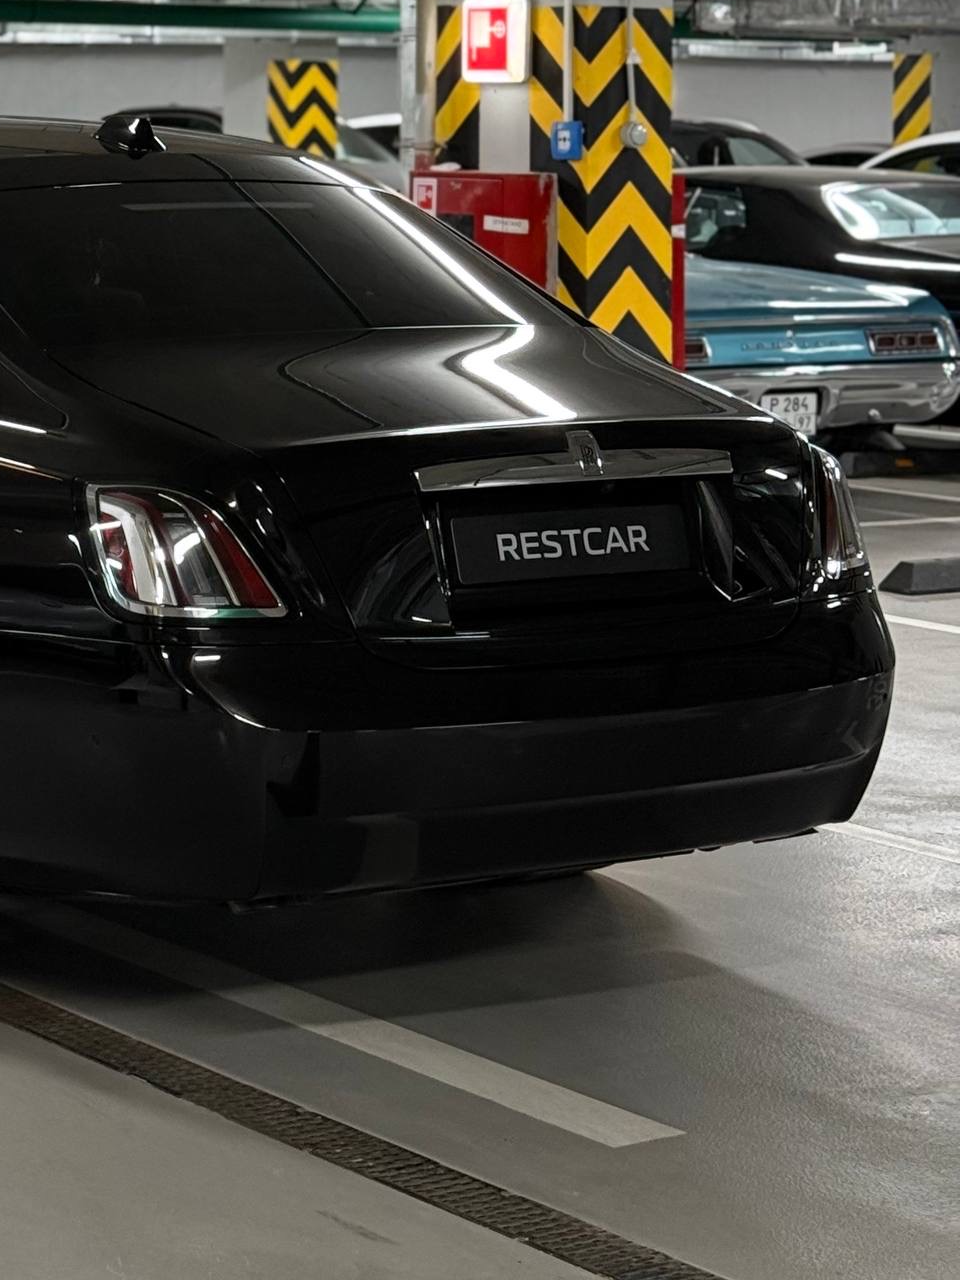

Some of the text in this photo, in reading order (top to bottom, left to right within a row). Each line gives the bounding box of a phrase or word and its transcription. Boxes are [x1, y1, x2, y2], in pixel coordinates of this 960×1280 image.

[770, 396, 809, 413] P 284
[798, 415, 811, 429] 97
[496, 525, 650, 561] RESTCAR
